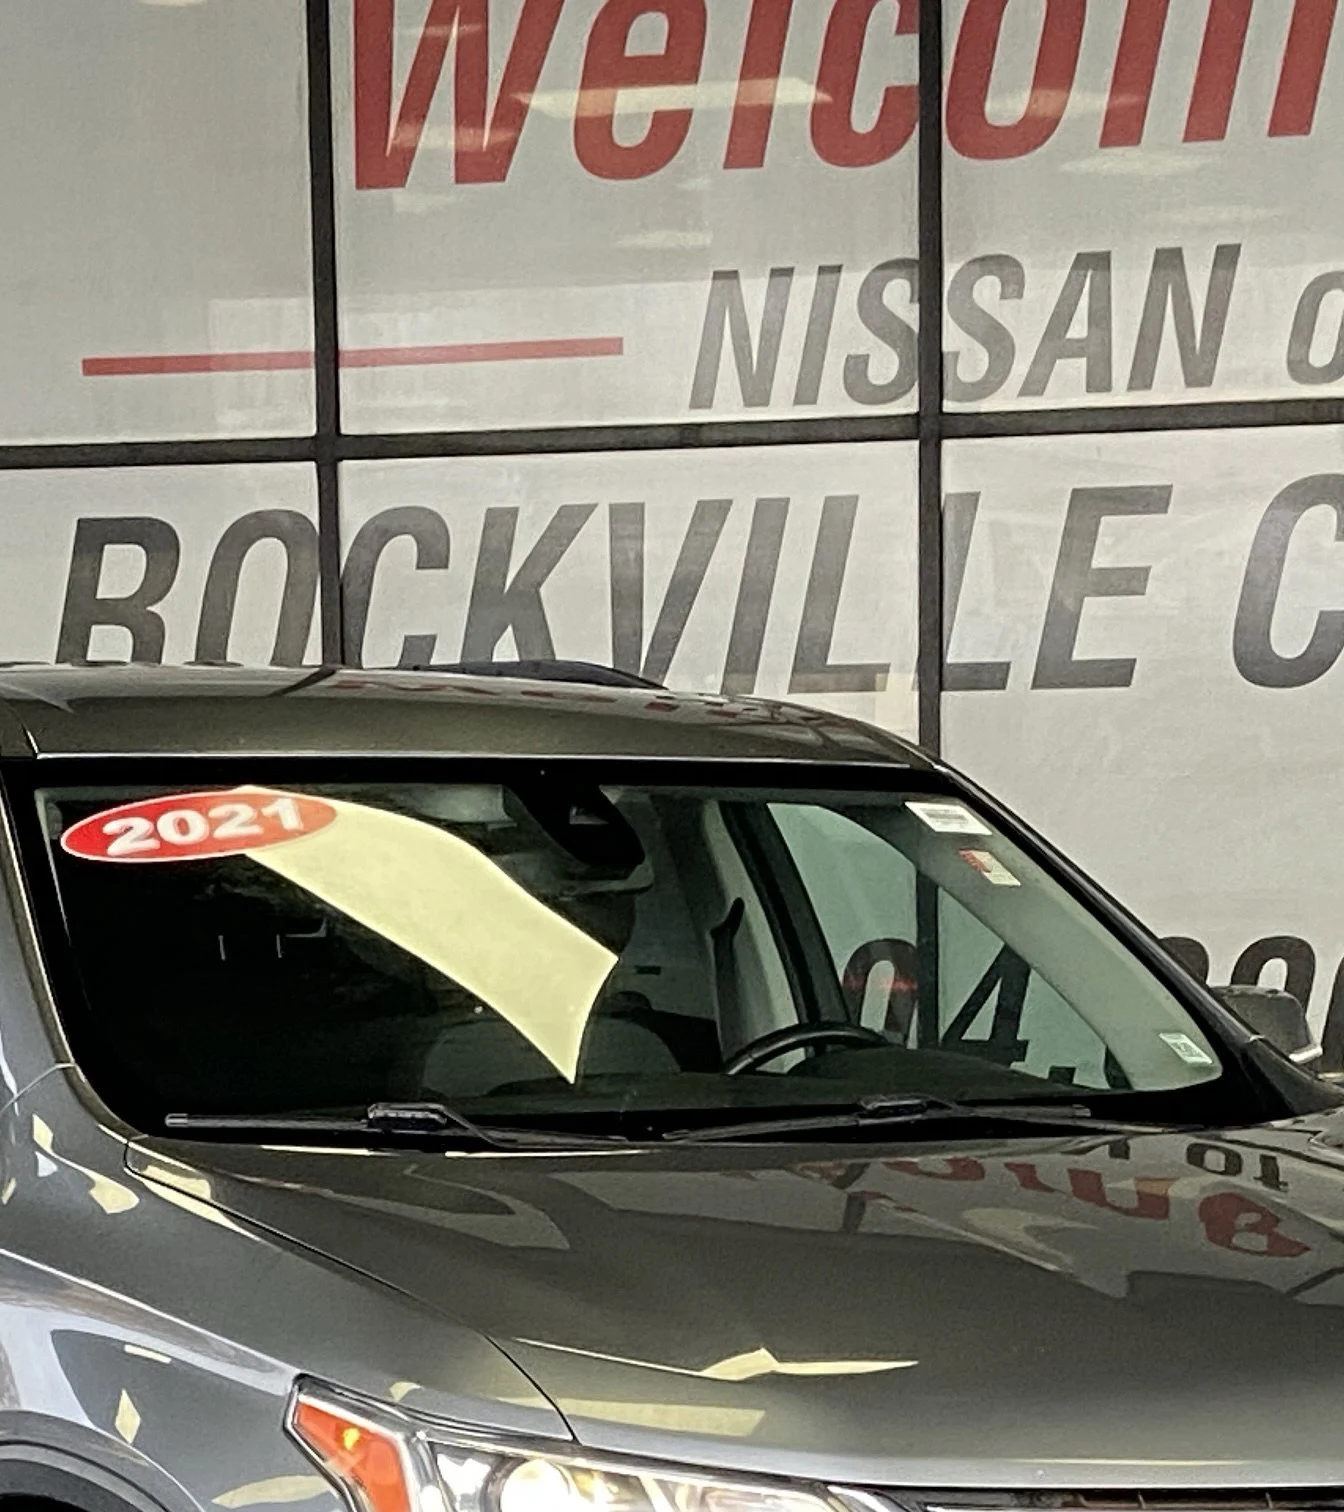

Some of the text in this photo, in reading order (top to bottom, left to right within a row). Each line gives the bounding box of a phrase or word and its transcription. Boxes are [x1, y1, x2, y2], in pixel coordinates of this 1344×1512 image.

[689, 243, 1241, 409] NISSAN
[56, 484, 1172, 694] ROCKVILLE
[102, 797, 303, 857] 2021
